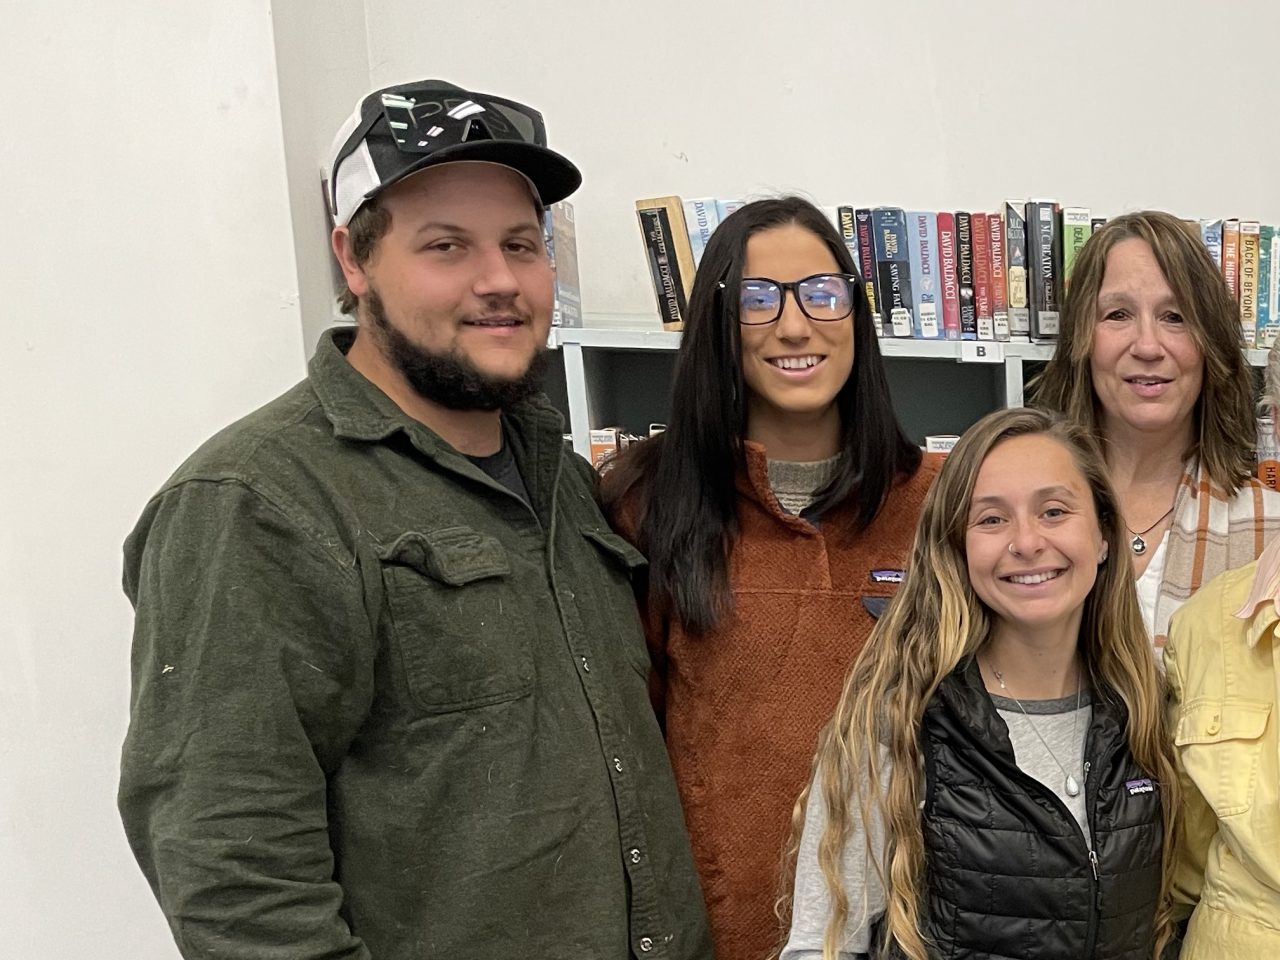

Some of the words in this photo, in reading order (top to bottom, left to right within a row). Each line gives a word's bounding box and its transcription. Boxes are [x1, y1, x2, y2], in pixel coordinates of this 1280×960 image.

[695, 201, 709, 230] DAVID
[841, 212, 855, 240] DAVID
[917, 215, 928, 239] DAVID
[958, 215, 970, 241] DAVID
[860, 224, 870, 245] DAVID
[941, 231, 952, 258] DAVID
[975, 217, 984, 244] DAVID
[990, 217, 1001, 245] DAVID
[1074, 227, 1084, 245] DEAL
[860, 244, 873, 279] BALDACCI
[919, 240, 931, 275] BALDACCI
[960, 242, 972, 284] BALDACCI
[975, 244, 987, 284] BALDACCI
[992, 244, 1003, 278] BALDACCI
[1041, 244, 1053, 279] BEATON
[1226, 243, 1236, 259] THE
[1244, 240, 1255, 265] BACK
[659, 264, 678, 300] BALDACCI
[889, 263, 901, 292] SAVING
[942, 257, 956, 300] BALDACCI
[1243, 265, 1254, 279] OF
[667, 299, 681, 321] DAVID
[893, 292, 902, 309] FAIT
[1243, 282, 1254, 319] BEYOND
[976, 346, 987, 357] B
